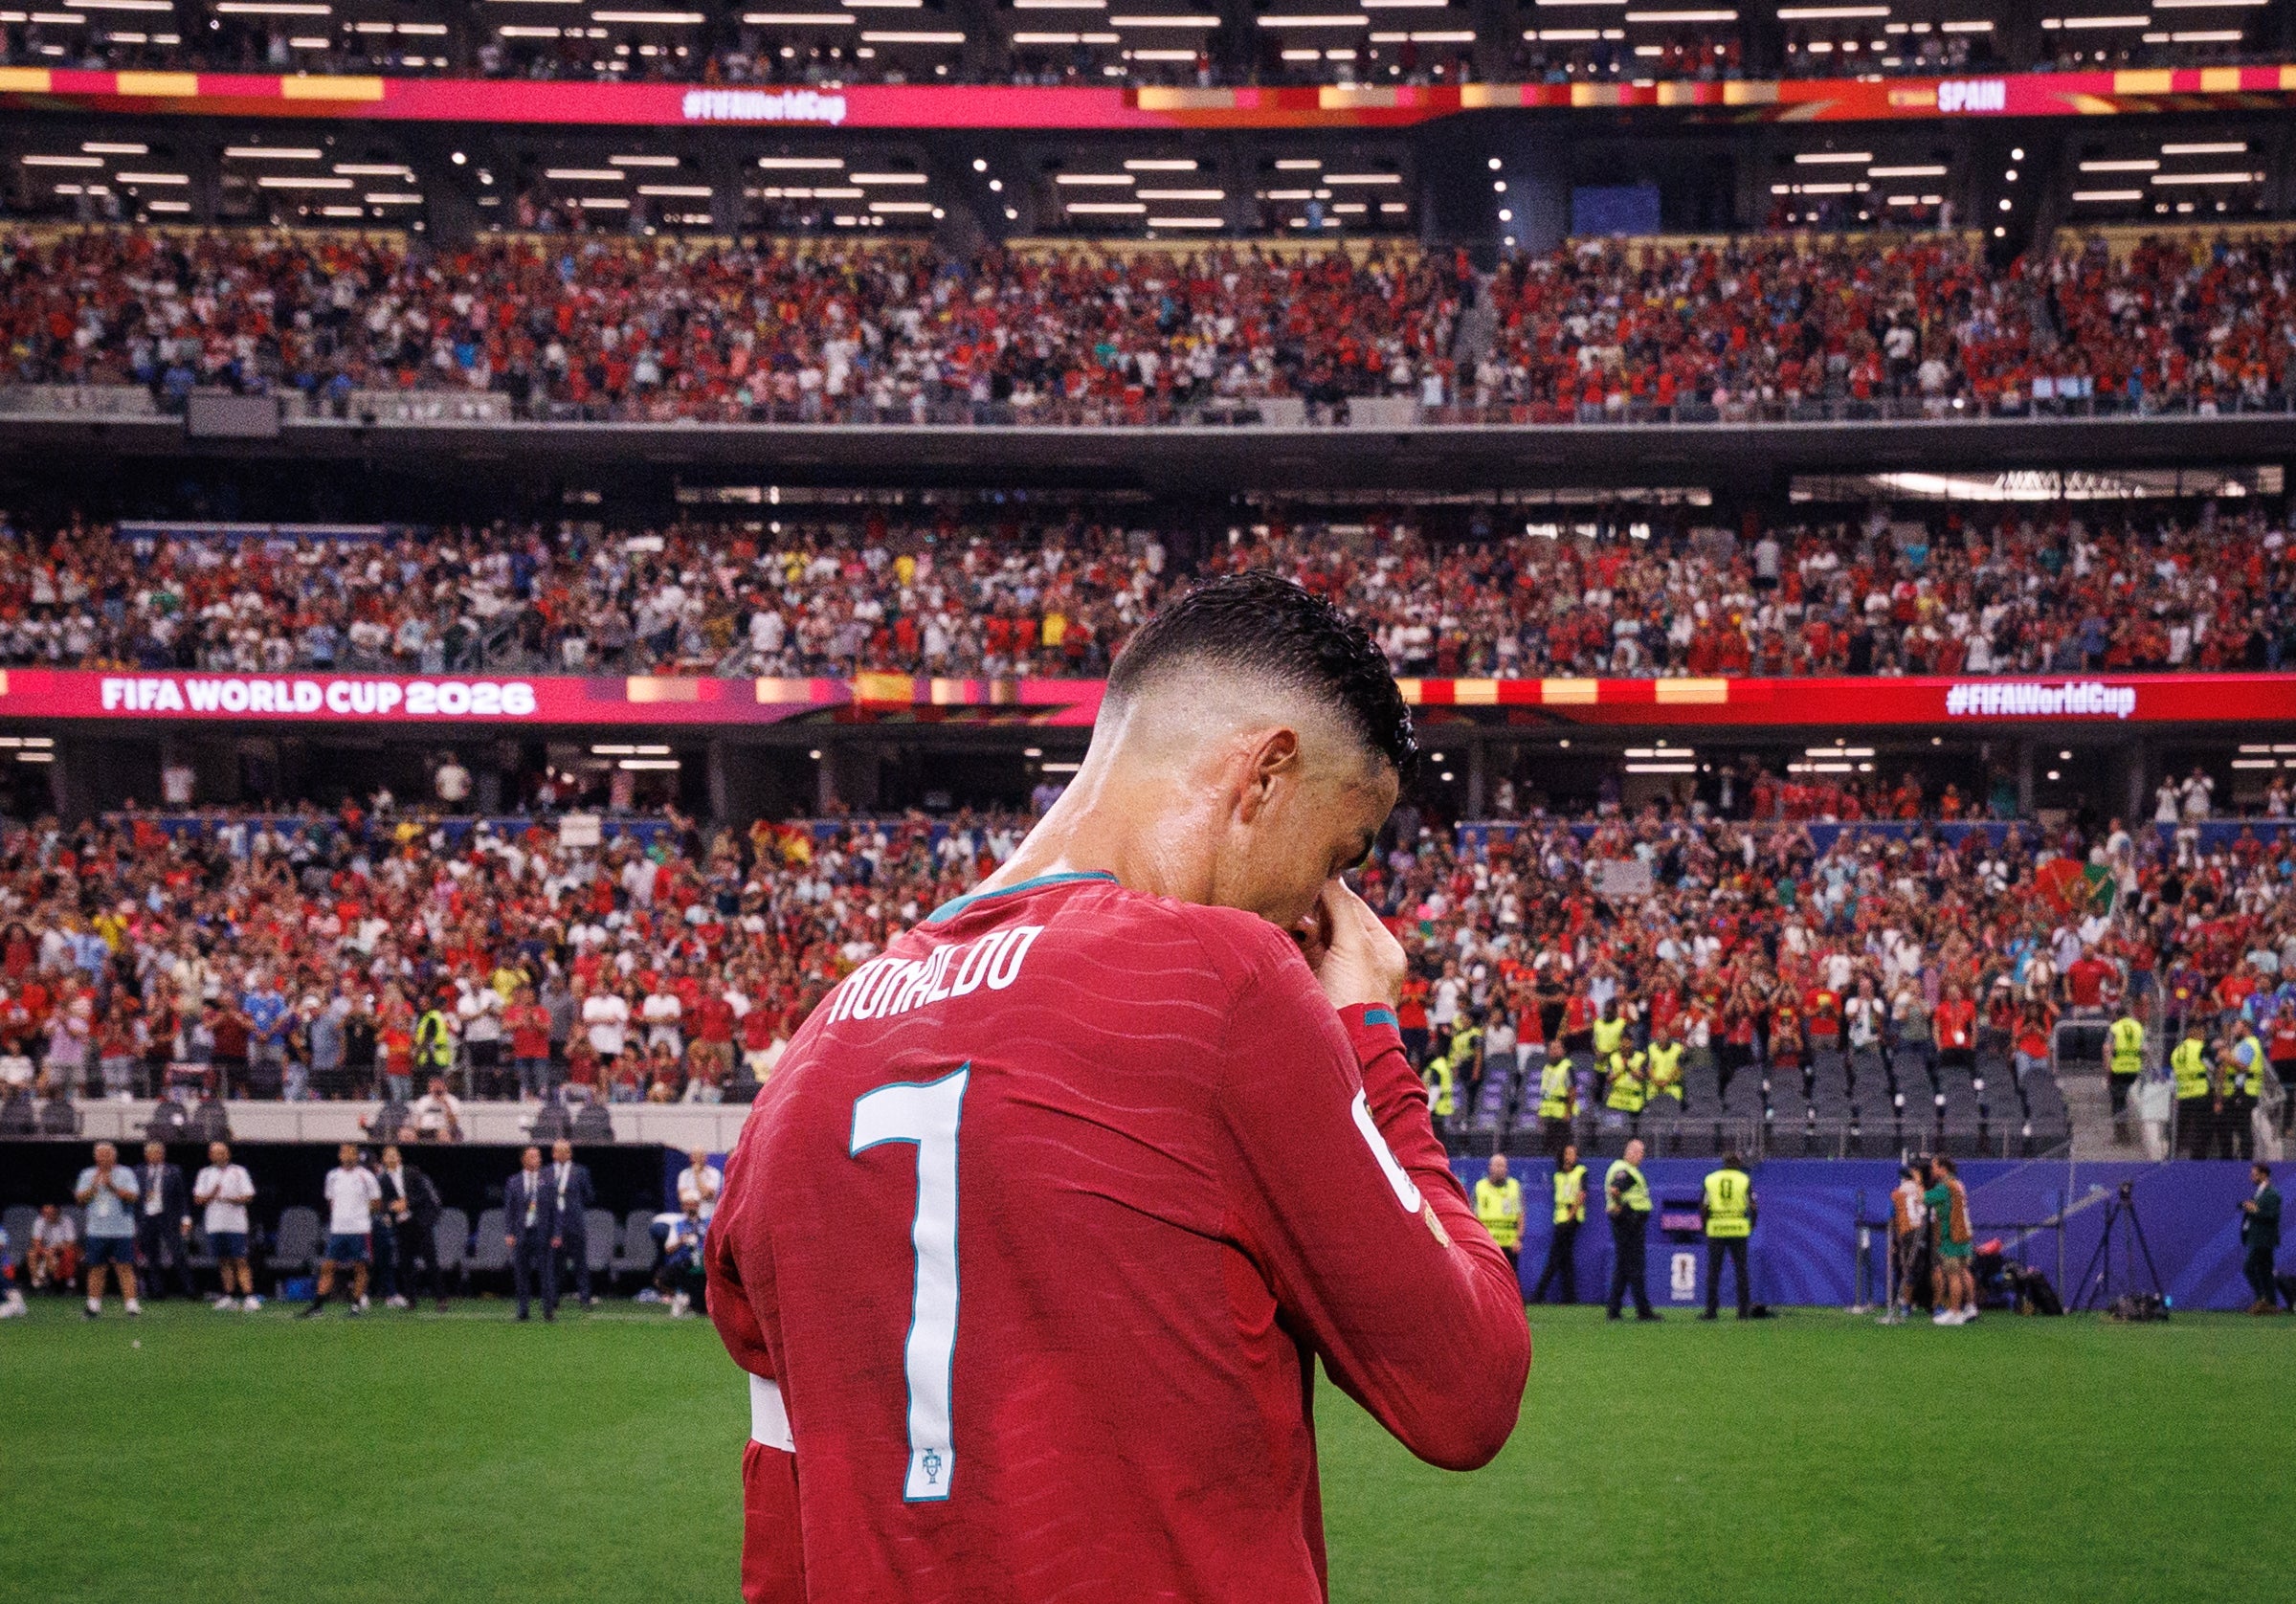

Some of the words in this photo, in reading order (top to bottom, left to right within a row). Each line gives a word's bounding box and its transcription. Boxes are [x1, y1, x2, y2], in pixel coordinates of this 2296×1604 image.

[682, 90, 846, 125] #FIFAWorldCup
[1938, 80, 2006, 112] SPAIN
[101, 678, 185, 710] FIFA
[185, 679, 323, 712] WORLD
[325, 679, 403, 713] CUP
[405, 680, 536, 715] 2026
[1946, 681, 2135, 719] #FIFAWorldCup
[826, 925, 1045, 1025] RONALDO
[850, 1060, 970, 1502] 7
